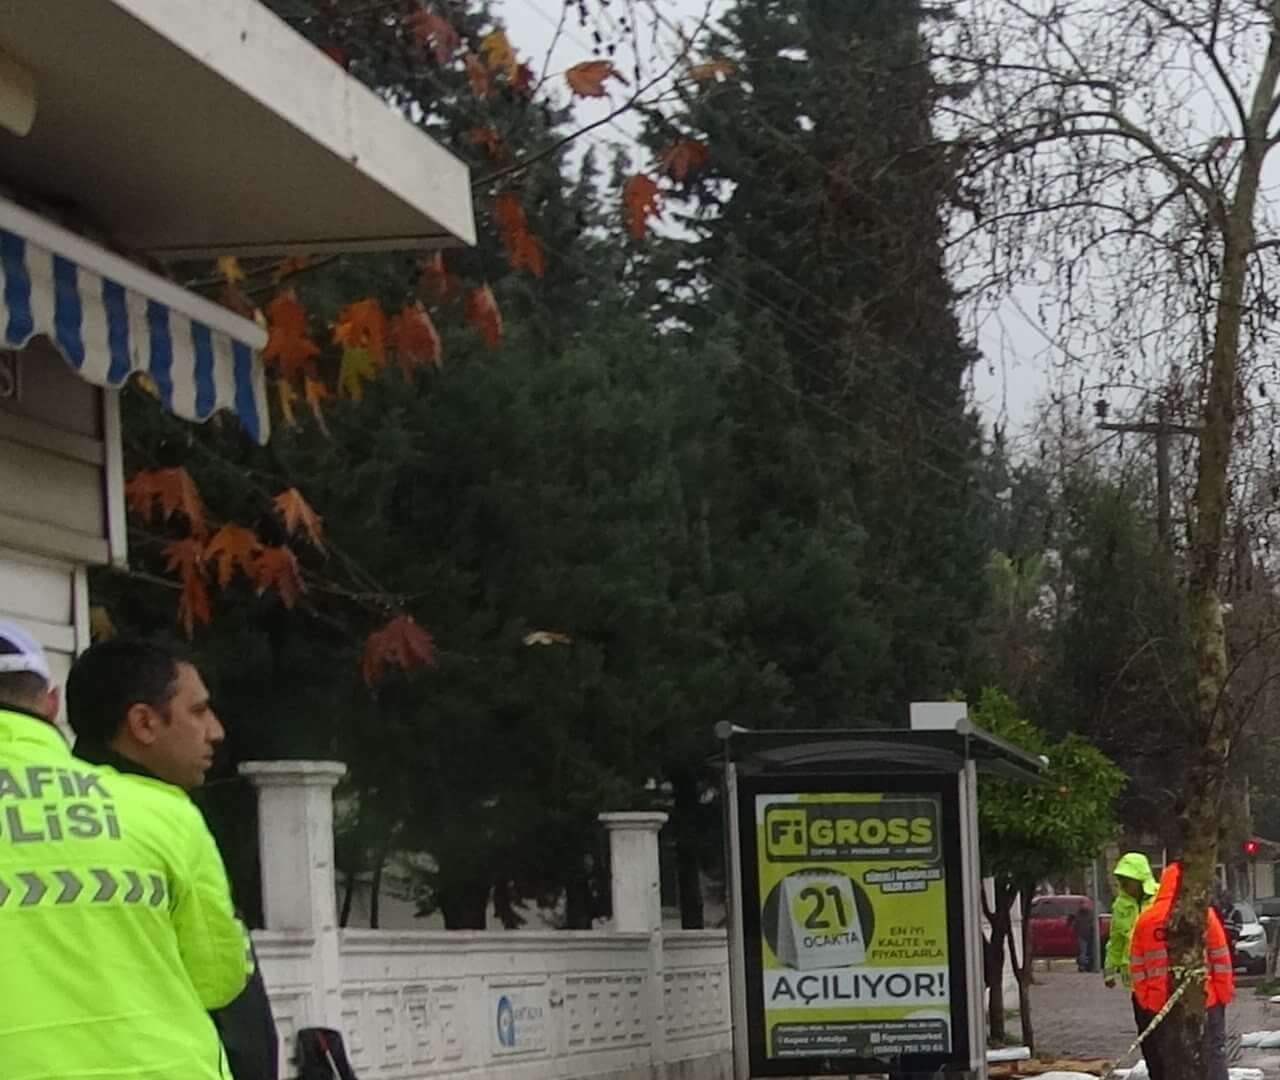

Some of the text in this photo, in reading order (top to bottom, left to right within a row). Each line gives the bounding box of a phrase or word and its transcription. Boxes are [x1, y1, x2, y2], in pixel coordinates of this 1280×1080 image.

[0, 803, 121, 842] LİSİ
[800, 886, 848, 929] 21
[772, 973, 945, 1004] AÇILIYOR!
